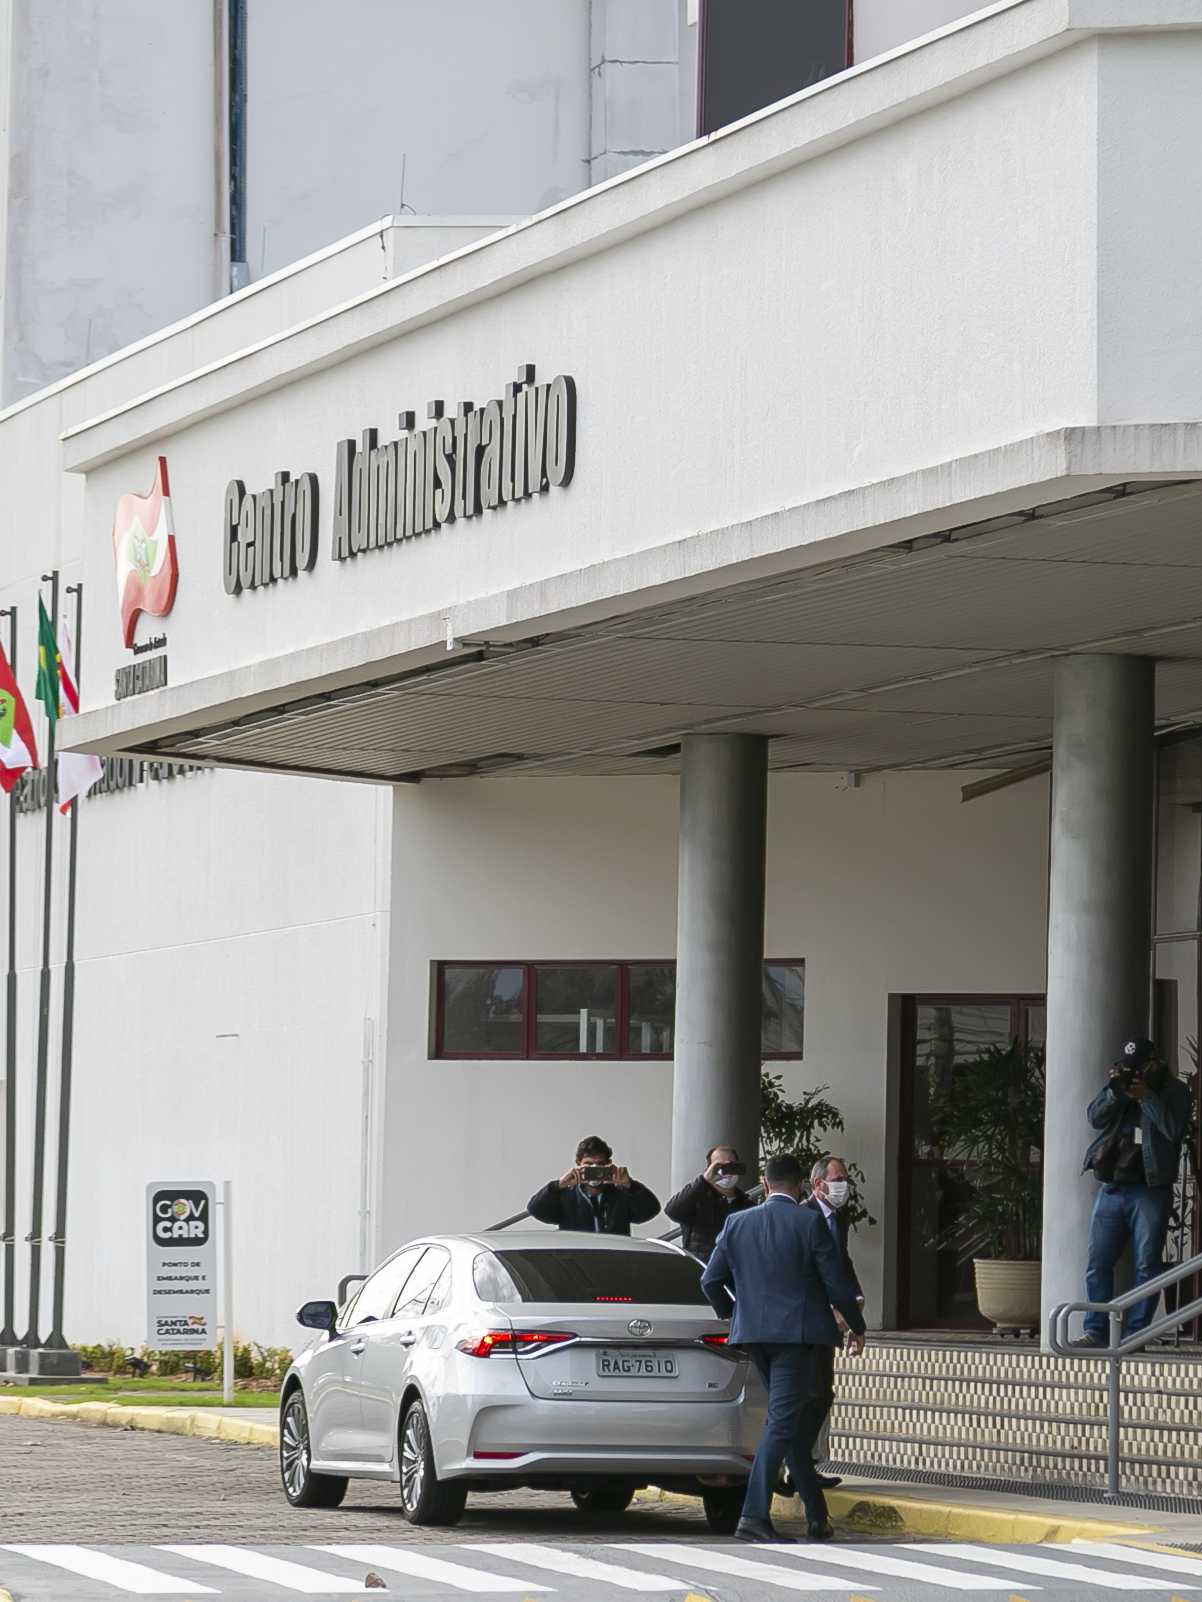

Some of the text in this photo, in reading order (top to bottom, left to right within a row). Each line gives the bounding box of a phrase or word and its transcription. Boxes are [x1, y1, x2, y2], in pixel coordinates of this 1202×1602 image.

[222, 363, 577, 595] Centro Administrativo
[155, 1198, 206, 1220] GOV
[155, 1220, 206, 1239] CAR
[152, 1288, 211, 1296] DESEMBARQUE
[156, 1319, 190, 1328] SANTA
[156, 1328, 208, 1336] CATARINA
